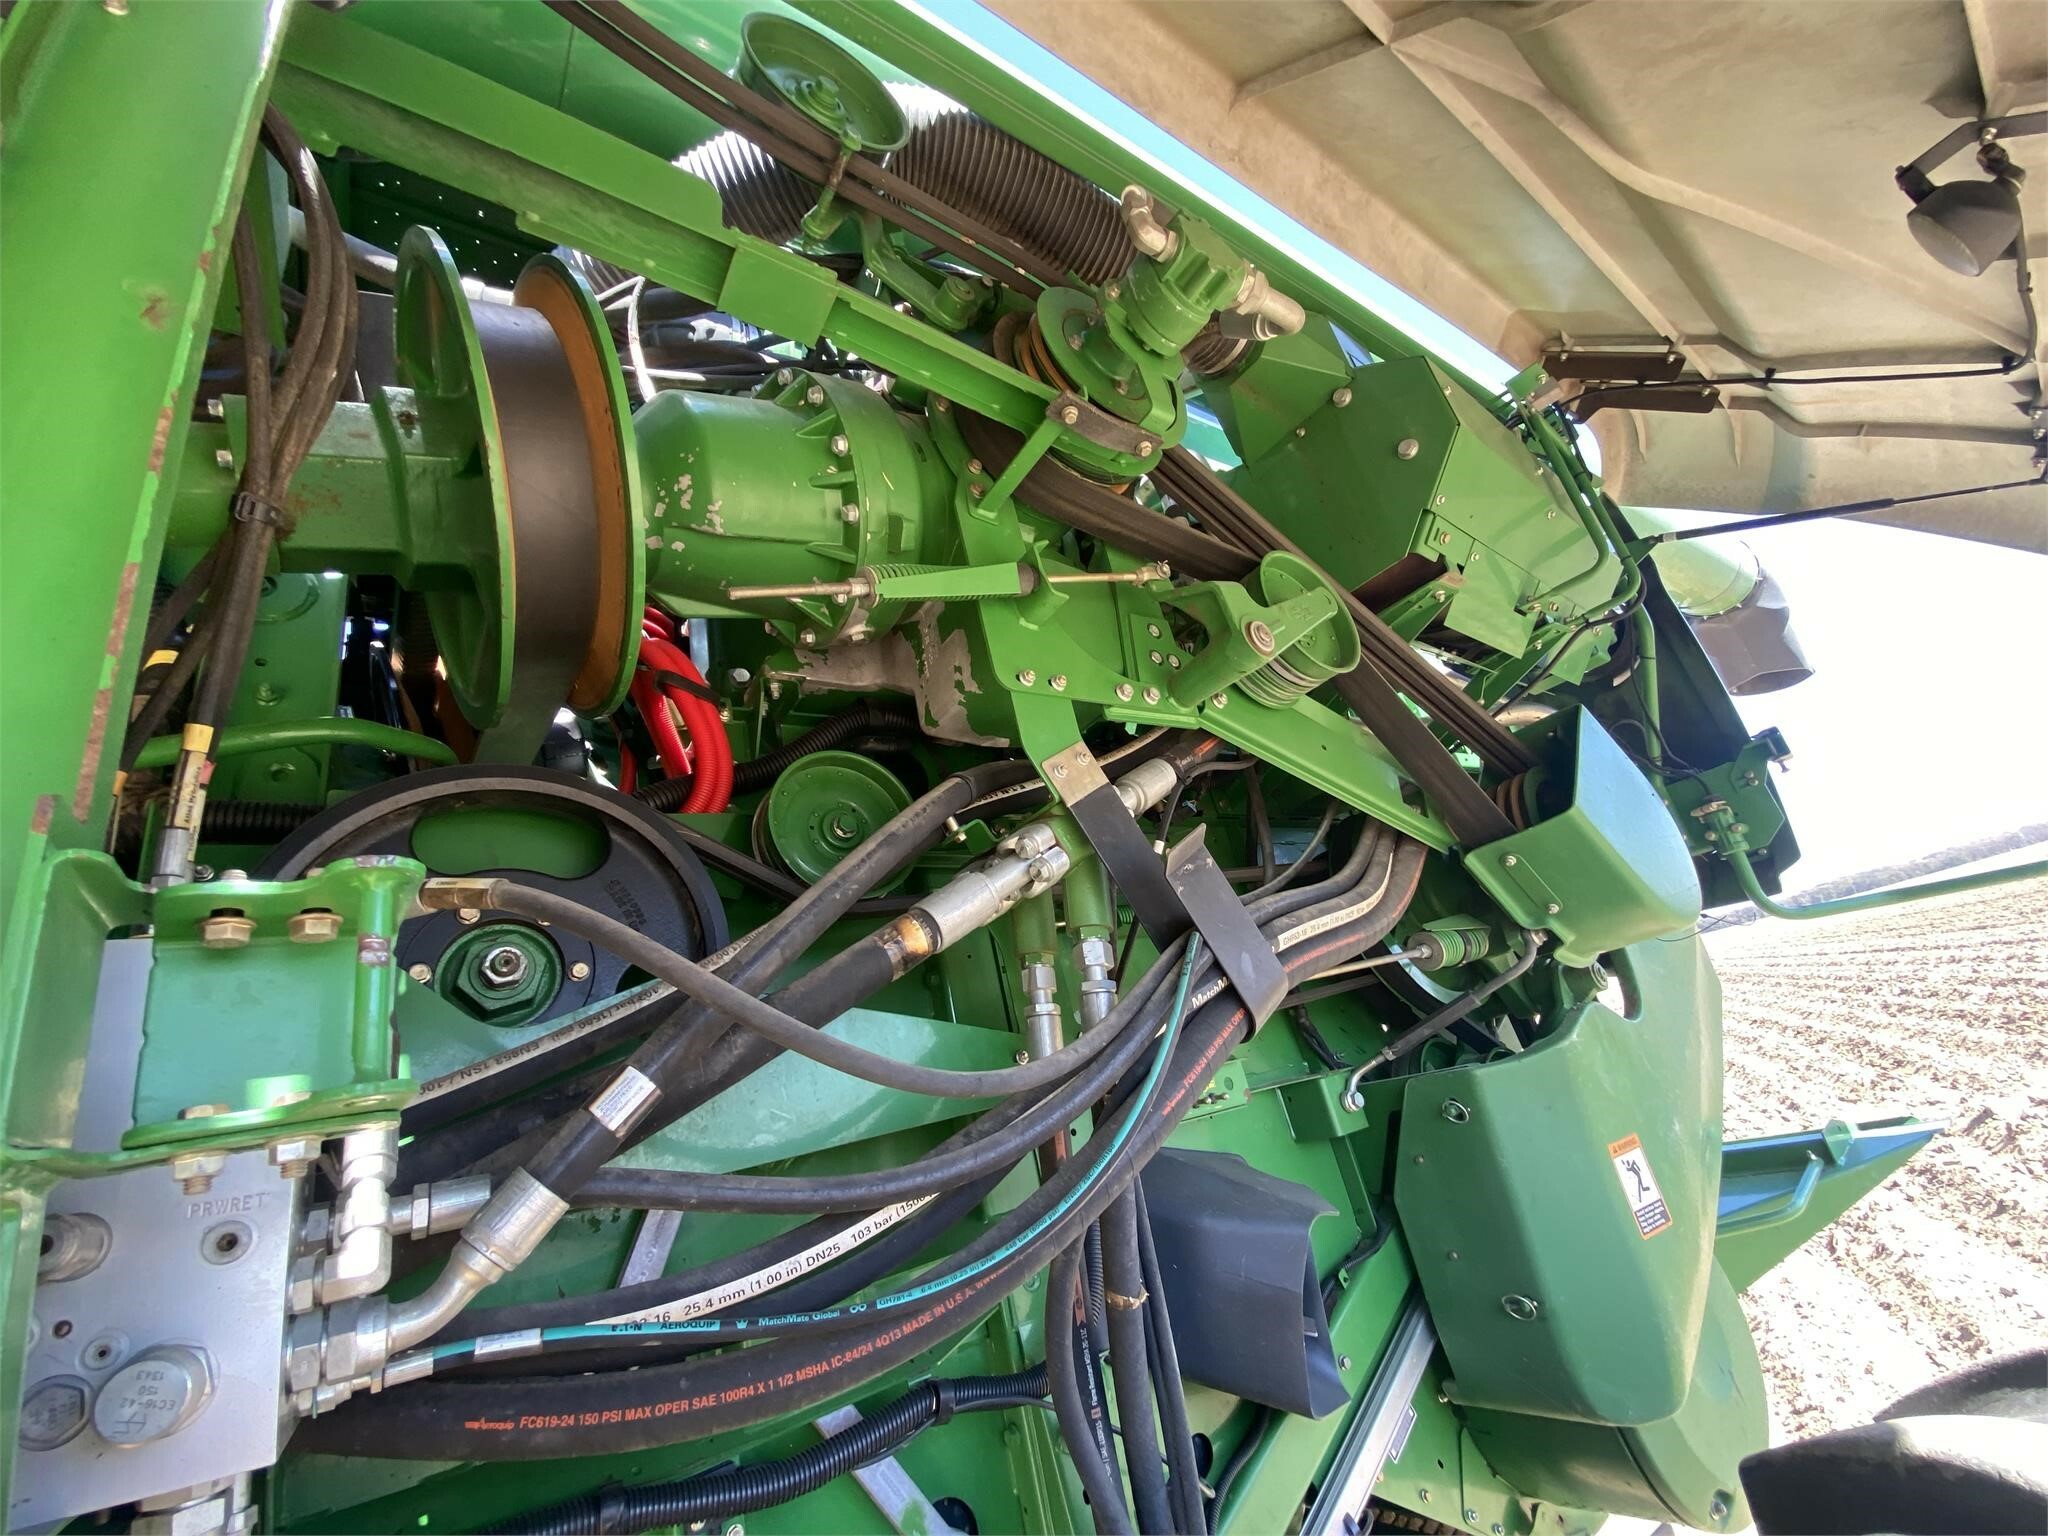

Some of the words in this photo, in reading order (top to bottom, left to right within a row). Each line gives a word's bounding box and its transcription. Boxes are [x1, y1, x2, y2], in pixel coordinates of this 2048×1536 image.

[660, 1319, 716, 1330] AEROQUIP
[758, 1314, 810, 1327] MatchMate
[812, 1310, 841, 1321] Global
[1017, 1233, 1030, 1246] bar
[683, 1298, 714, 1316] 25.4
[718, 1288, 746, 1305] mm
[785, 1260, 804, 1278] in)
[806, 1242, 842, 1267] DN25
[851, 1225, 872, 1243] 103
[873, 1214, 897, 1230] bar
[137, 1385, 160, 1396] 150
[519, 1410, 575, 1430] FC619-24
[579, 1407, 600, 1426] 150
[602, 1405, 622, 1424] PSI
[625, 1404, 652, 1421] MAX
[655, 1398, 690, 1417] OPER
[691, 1393, 718, 1411] SAE
[719, 1384, 755, 1405] 100R4
[757, 1380, 766, 1395] X
[768, 1378, 775, 1391] 1
[777, 1373, 795, 1388] 1/2
[796, 1360, 830, 1382] MSHA
[831, 1342, 874, 1369] IC-84/24
[875, 1329, 902, 1348] 4Q13
[902, 1310, 933, 1335] MADE
[934, 1303, 946, 1318] IN
[946, 1287, 976, 1310] U.S.A.
